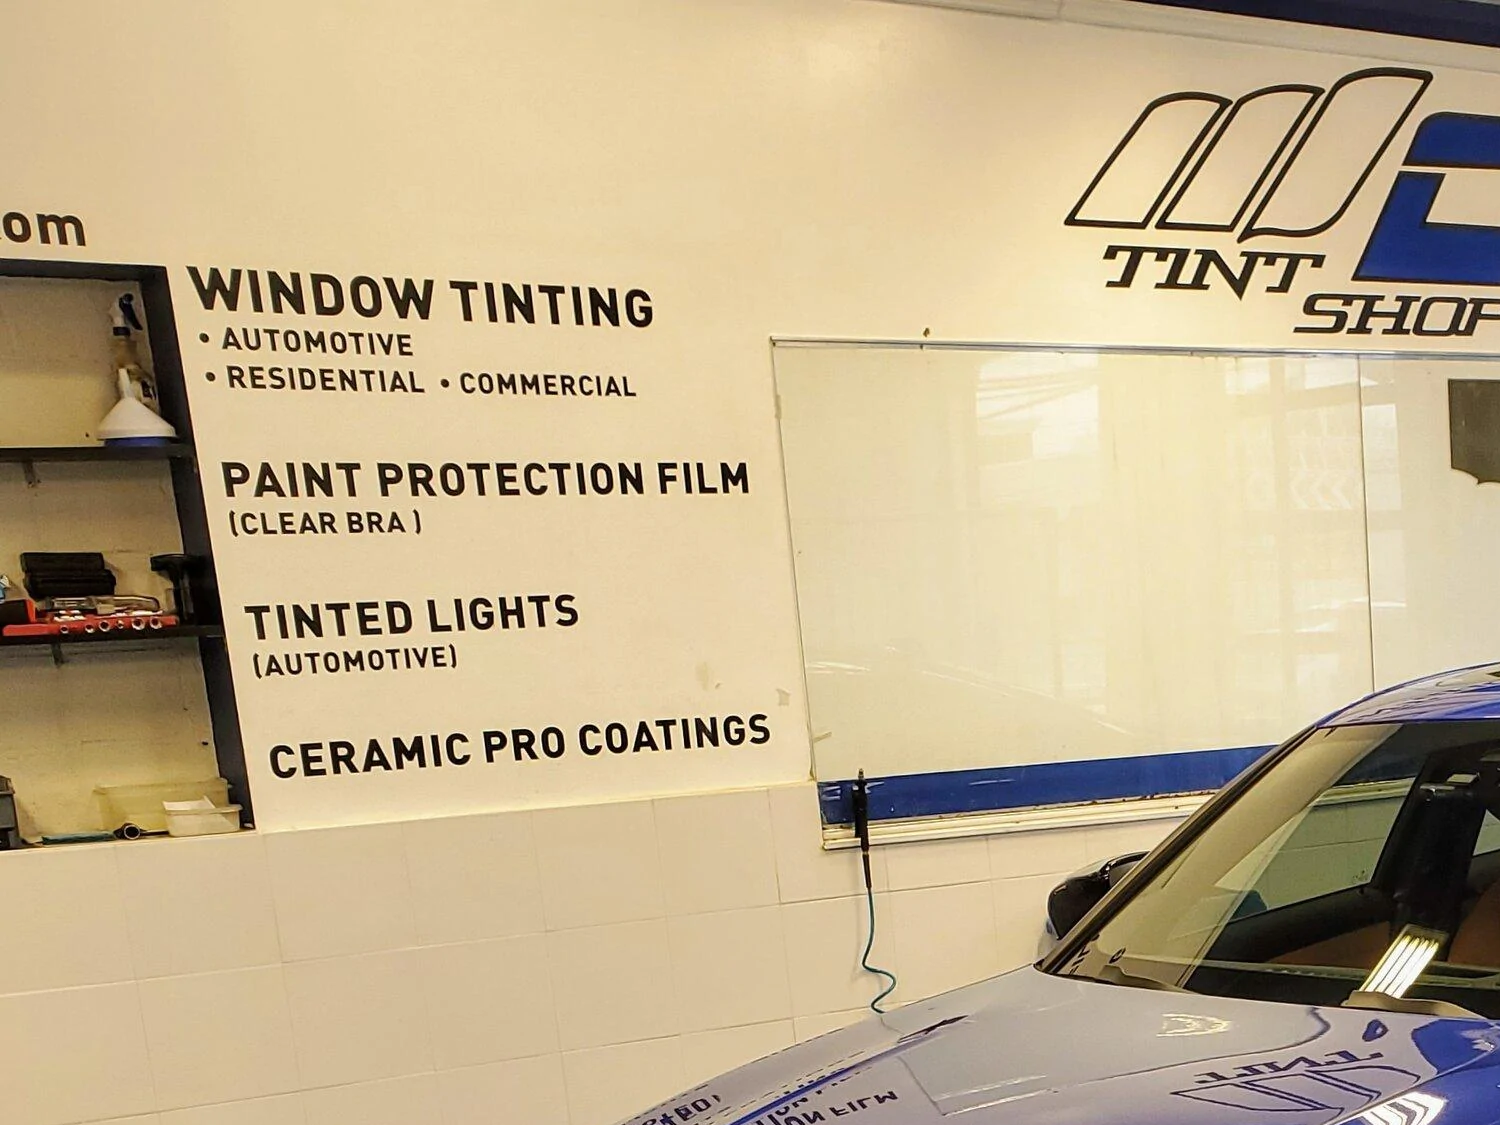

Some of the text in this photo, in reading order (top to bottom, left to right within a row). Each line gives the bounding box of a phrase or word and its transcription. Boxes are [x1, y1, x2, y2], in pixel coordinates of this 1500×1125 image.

[0, 211, 86, 246] om
[1103, 245, 1326, 299] TINT
[187, 266, 652, 327] WINDOW TINTING
[222, 328, 413, 356] AUTOMOTIVE
[226, 366, 636, 397] RESIDENTIAL COMMERCIAL
[222, 462, 748, 498] PAINT PROTECTION FILM
[229, 511, 337, 537] (CLEAR
[244, 595, 578, 639] TINTED LIGHTS
[253, 644, 456, 679] (AUTOMOTIVE)
[270, 714, 770, 778] CERAMIC PRO COATINGS
